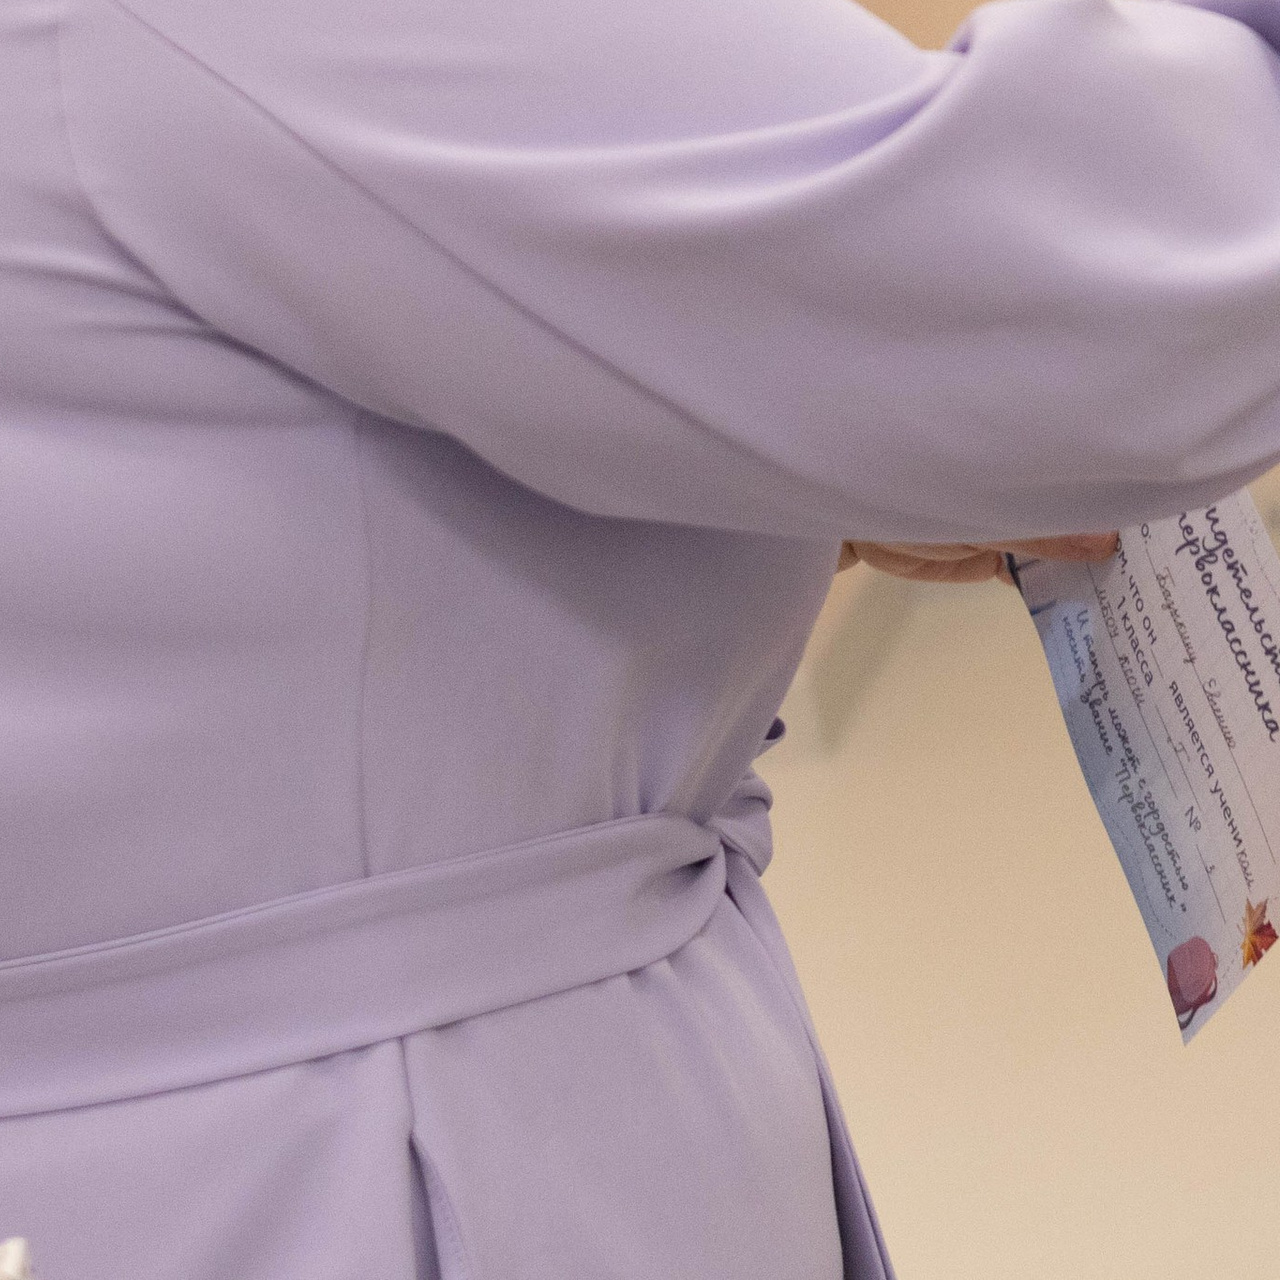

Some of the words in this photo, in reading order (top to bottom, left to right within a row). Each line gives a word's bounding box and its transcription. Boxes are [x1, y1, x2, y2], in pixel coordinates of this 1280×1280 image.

[1063, 617, 1086, 683] носить
[1080, 687, 1112, 755] звание
[1122, 613, 1153, 687] класса
[1129, 576, 1144, 612] что
[1143, 616, 1157, 645] он
[1169, 681, 1214, 778] является
[1076, 609, 1089, 630] И
[1084, 636, 1108, 700] теперь
[1109, 709, 1140, 772] может
[1144, 792, 1188, 891] гордостью
